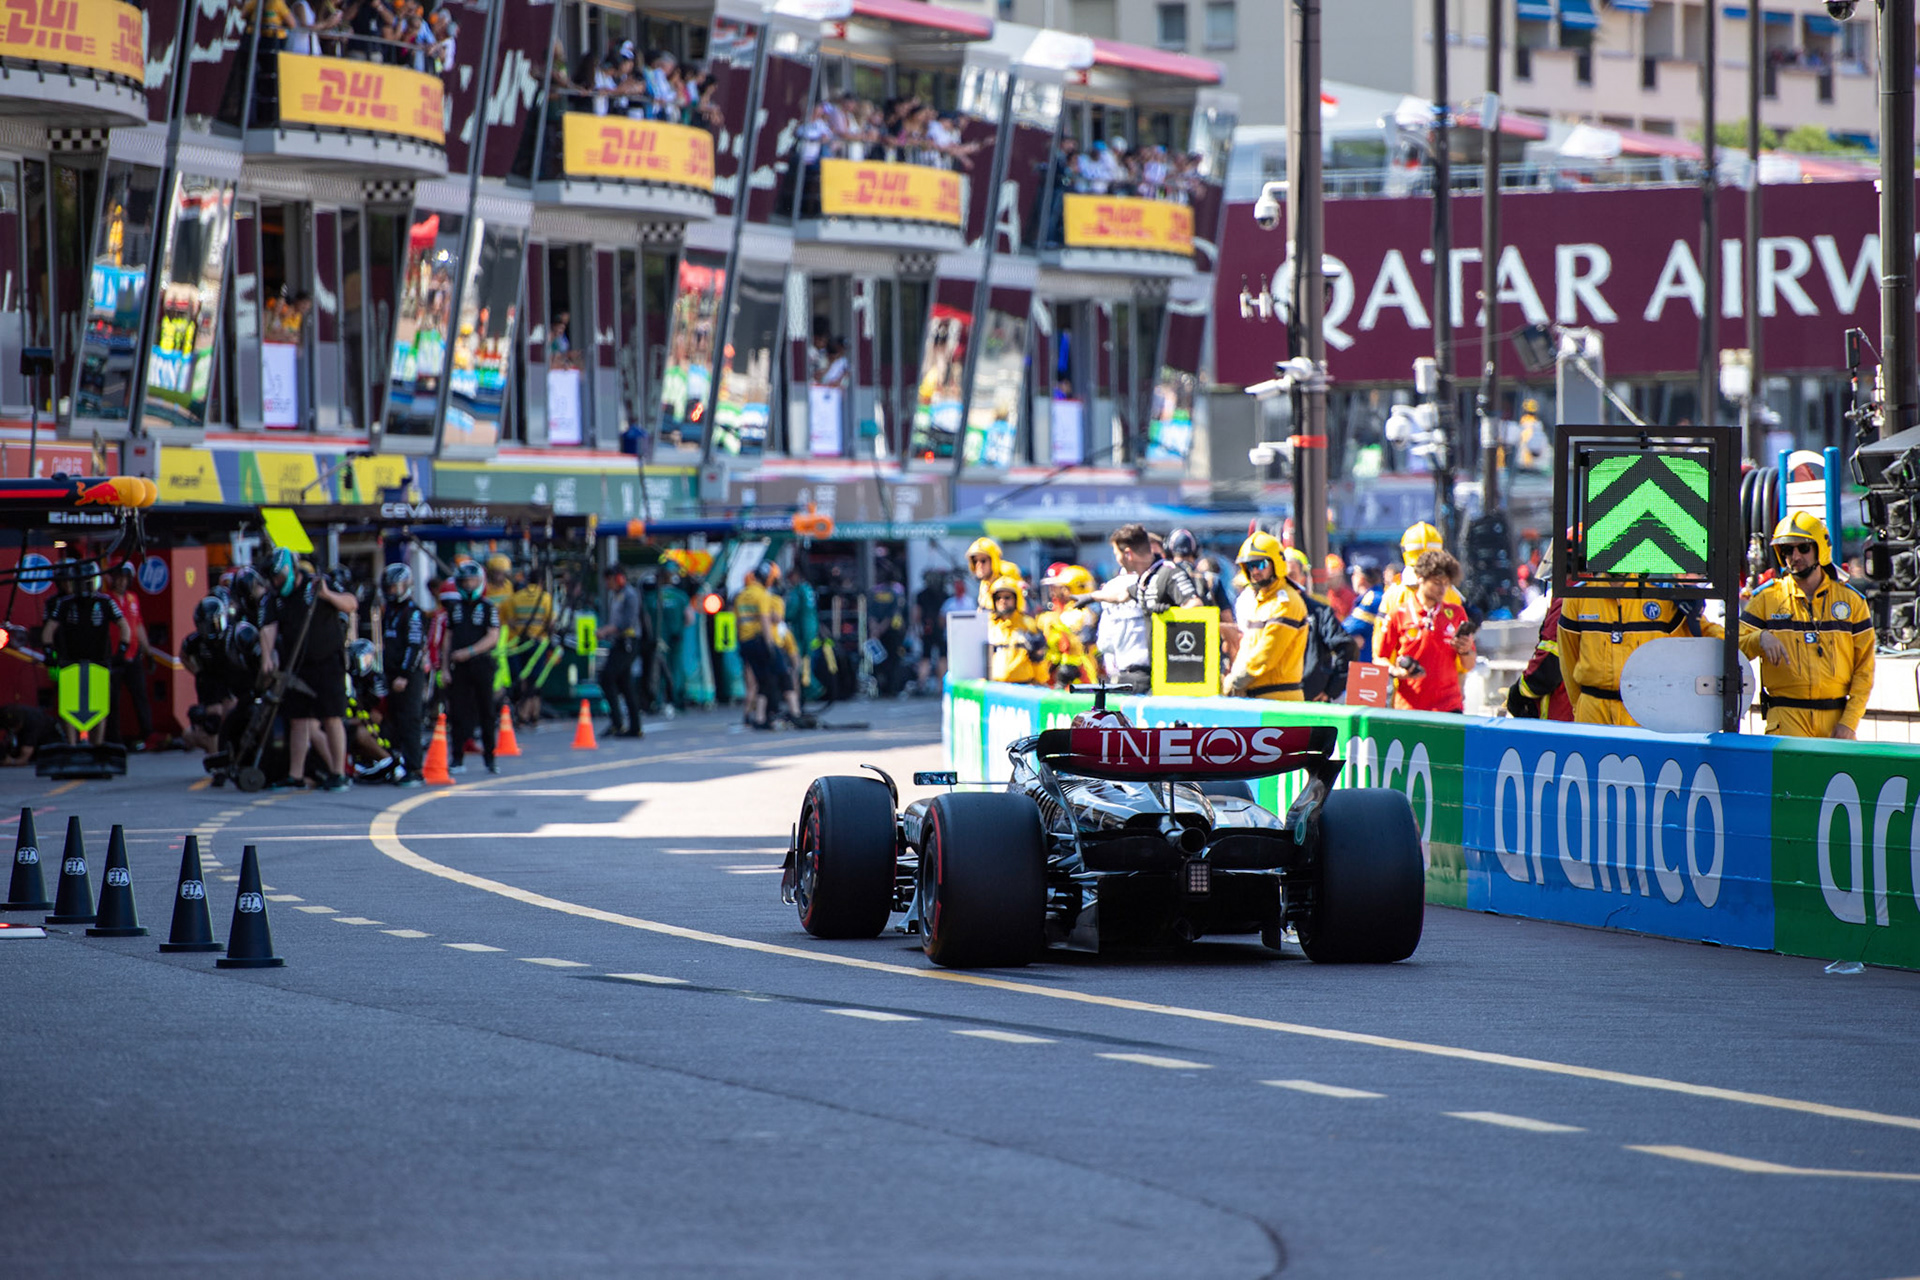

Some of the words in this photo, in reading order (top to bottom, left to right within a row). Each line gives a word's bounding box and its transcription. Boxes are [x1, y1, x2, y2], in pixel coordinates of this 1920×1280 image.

[5, 0, 84, 53] DHL
[319, 68, 387, 119] DHL
[600, 126, 660, 169] DHL
[857, 170, 911, 207] DHL
[1271, 244, 1618, 350] QATAR
[381, 503, 432, 518] CEVA
[1098, 728, 1284, 765] INEOS
[1494, 747, 1725, 909] aramco
[18, 850, 38, 863] FIA
[64, 860, 87, 875] FIA
[1817, 771, 1920, 927] ar
[107, 871, 130, 886] FIA
[181, 884, 206, 898] FIA
[239, 896, 263, 911] FIA
